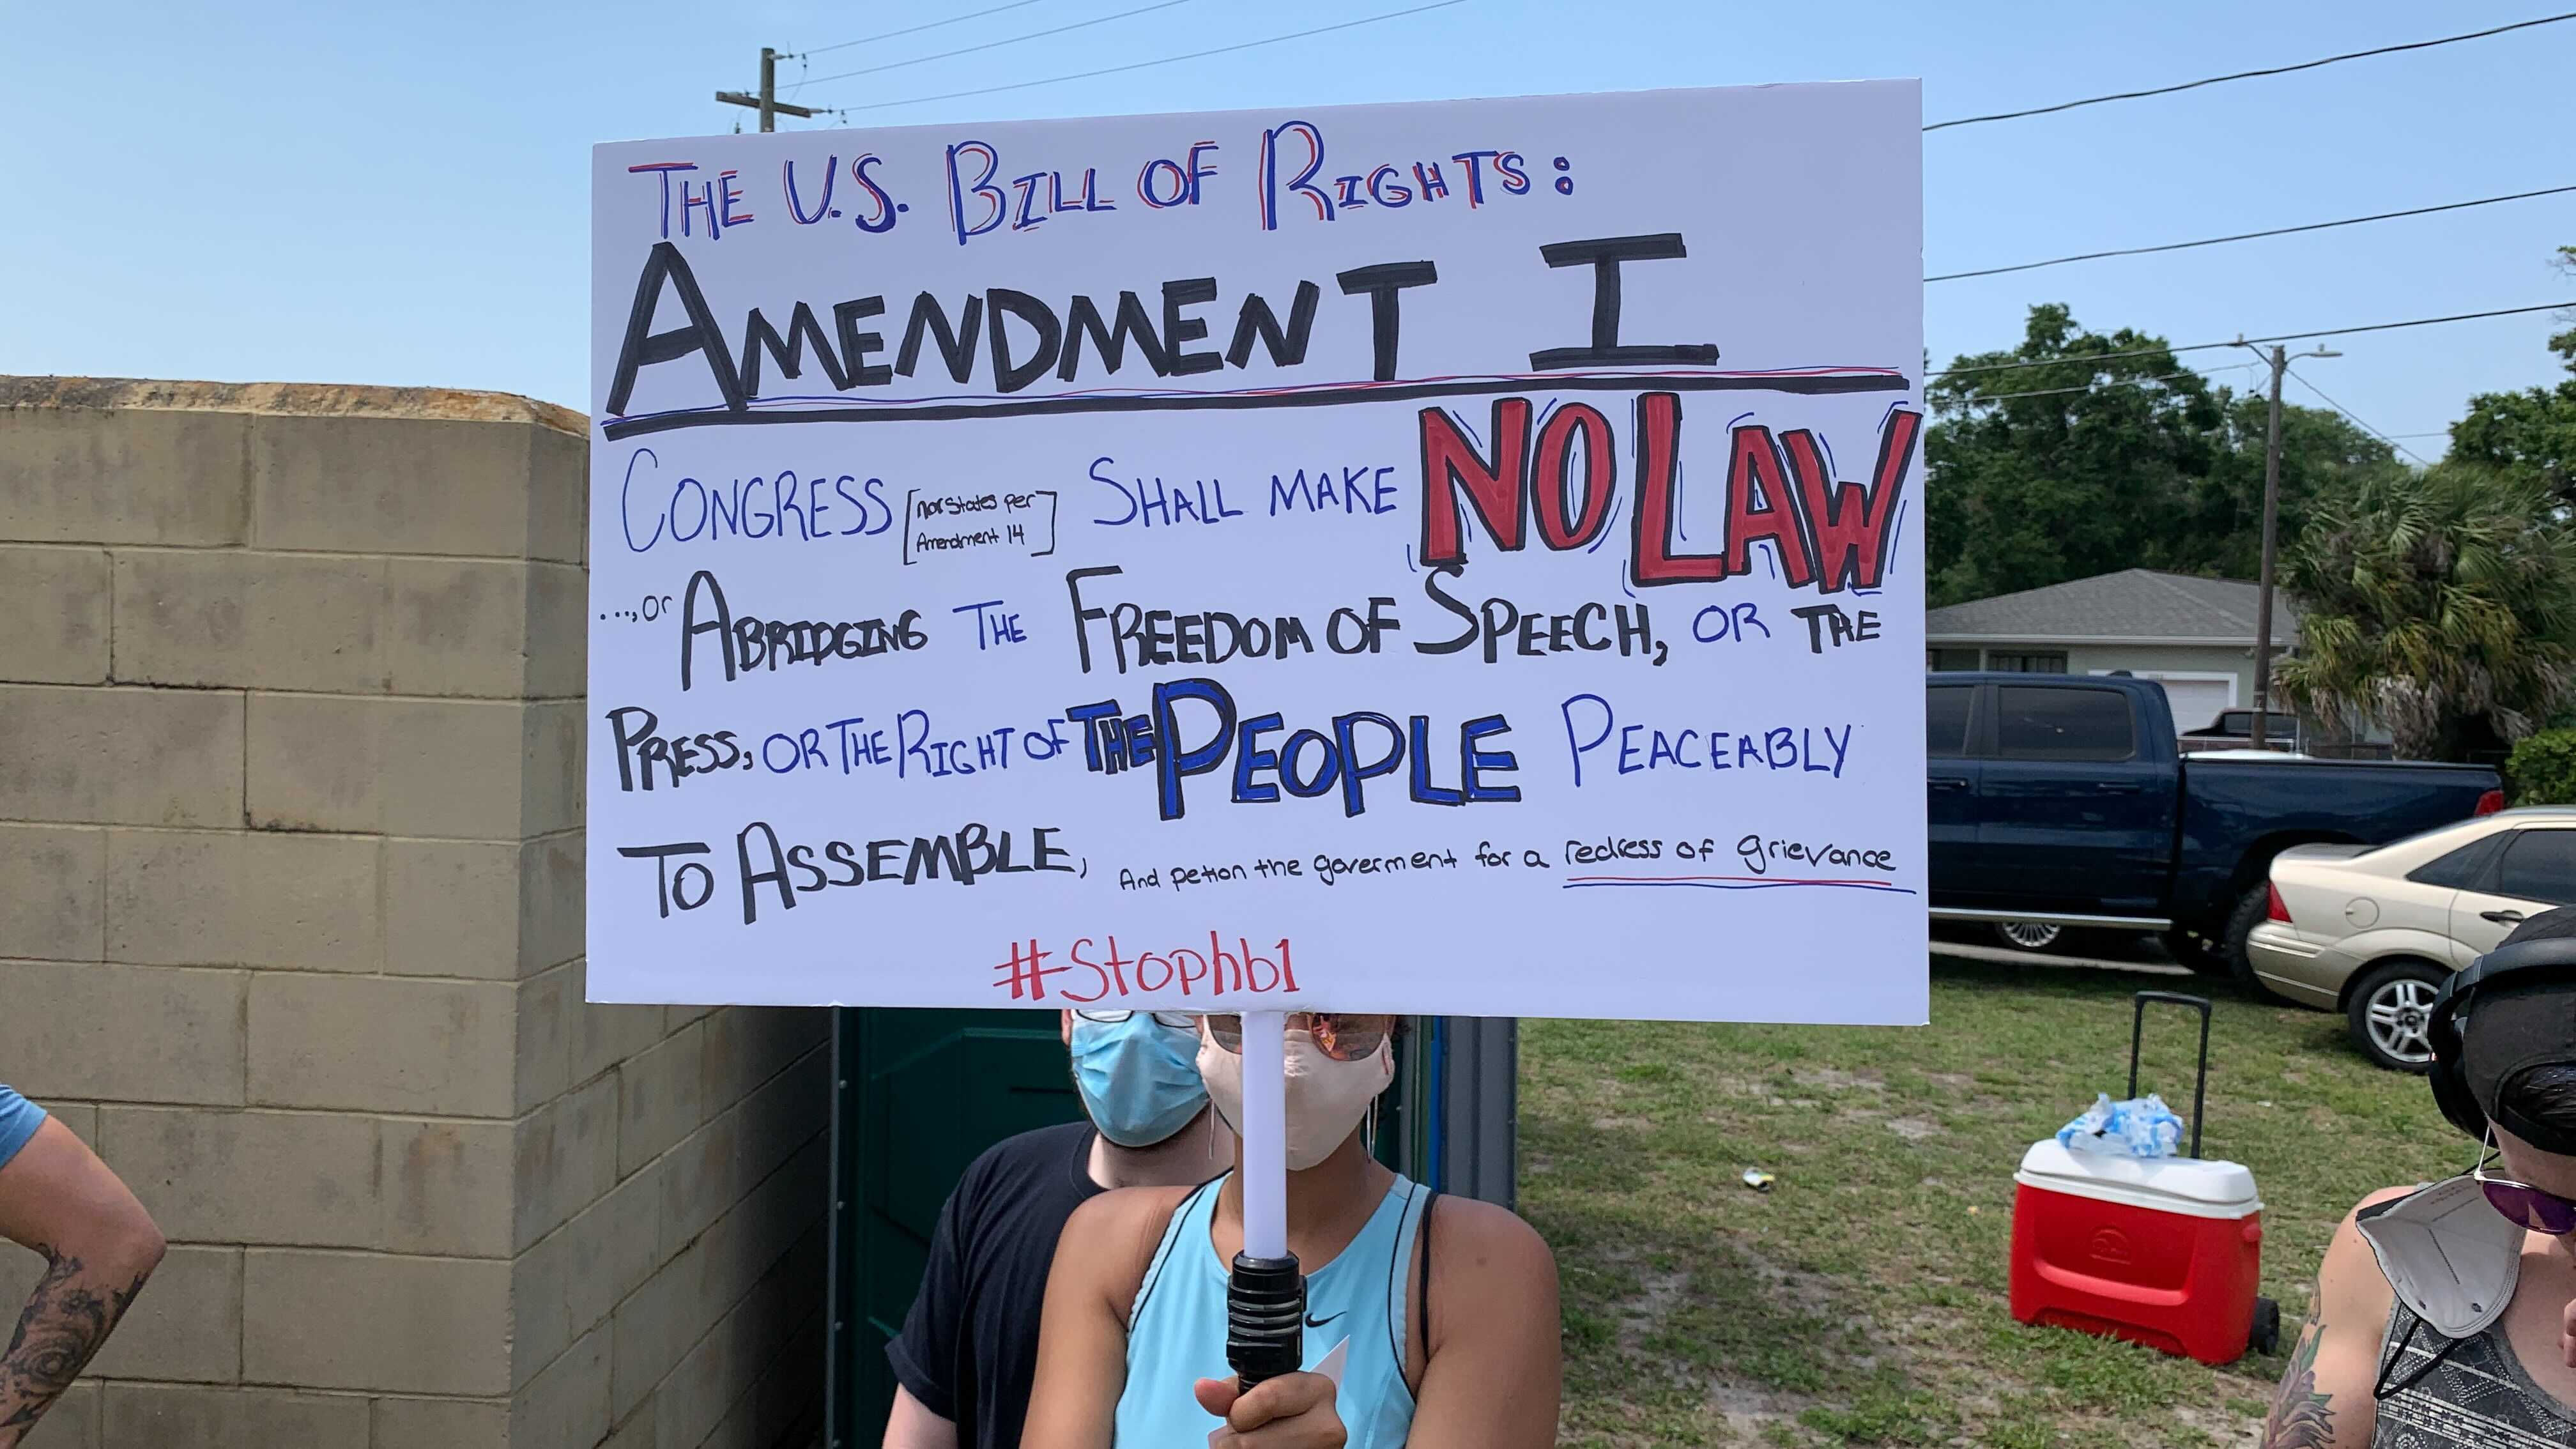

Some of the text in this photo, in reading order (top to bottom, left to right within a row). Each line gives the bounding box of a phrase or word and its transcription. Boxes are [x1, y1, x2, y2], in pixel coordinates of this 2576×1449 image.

[629, 162, 755, 240] THE
[783, 153, 909, 233] U.S.
[946, 140, 1117, 245] BILL
[1137, 140, 1219, 209] OF
[606, 232, 1720, 417] AMENDMENT I
[622, 448, 893, 552] CONGRESS
[916, 528, 999, 552] Amendment
[1089, 392, 1923, 594] SHALL MAKE NO LAW
[682, 570, 928, 691] ABRIDGING
[953, 600, 1027, 650] THE
[1066, 565, 1314, 674] FREEDOM
[1326, 597, 1400, 654] OF
[1413, 562, 1669, 666] SPEECH,
[1692, 602, 1770, 643] OR
[605, 678, 1851, 820] PRESS, OR THE RIGHT OF THE PEOPLE PEACEABLY
[617, 822, 1087, 925] TO ASSEMBLE,
[1120, 868, 1161, 891] And
[1254, 859, 1303, 878] the
[1314, 848, 1457, 886] goverment
[1475, 841, 1512, 868] for
[1524, 850, 1550, 868] a
[1564, 836, 1662, 864] redress
[1676, 839, 1714, 862] of
[1736, 834, 1896, 874] grievance
